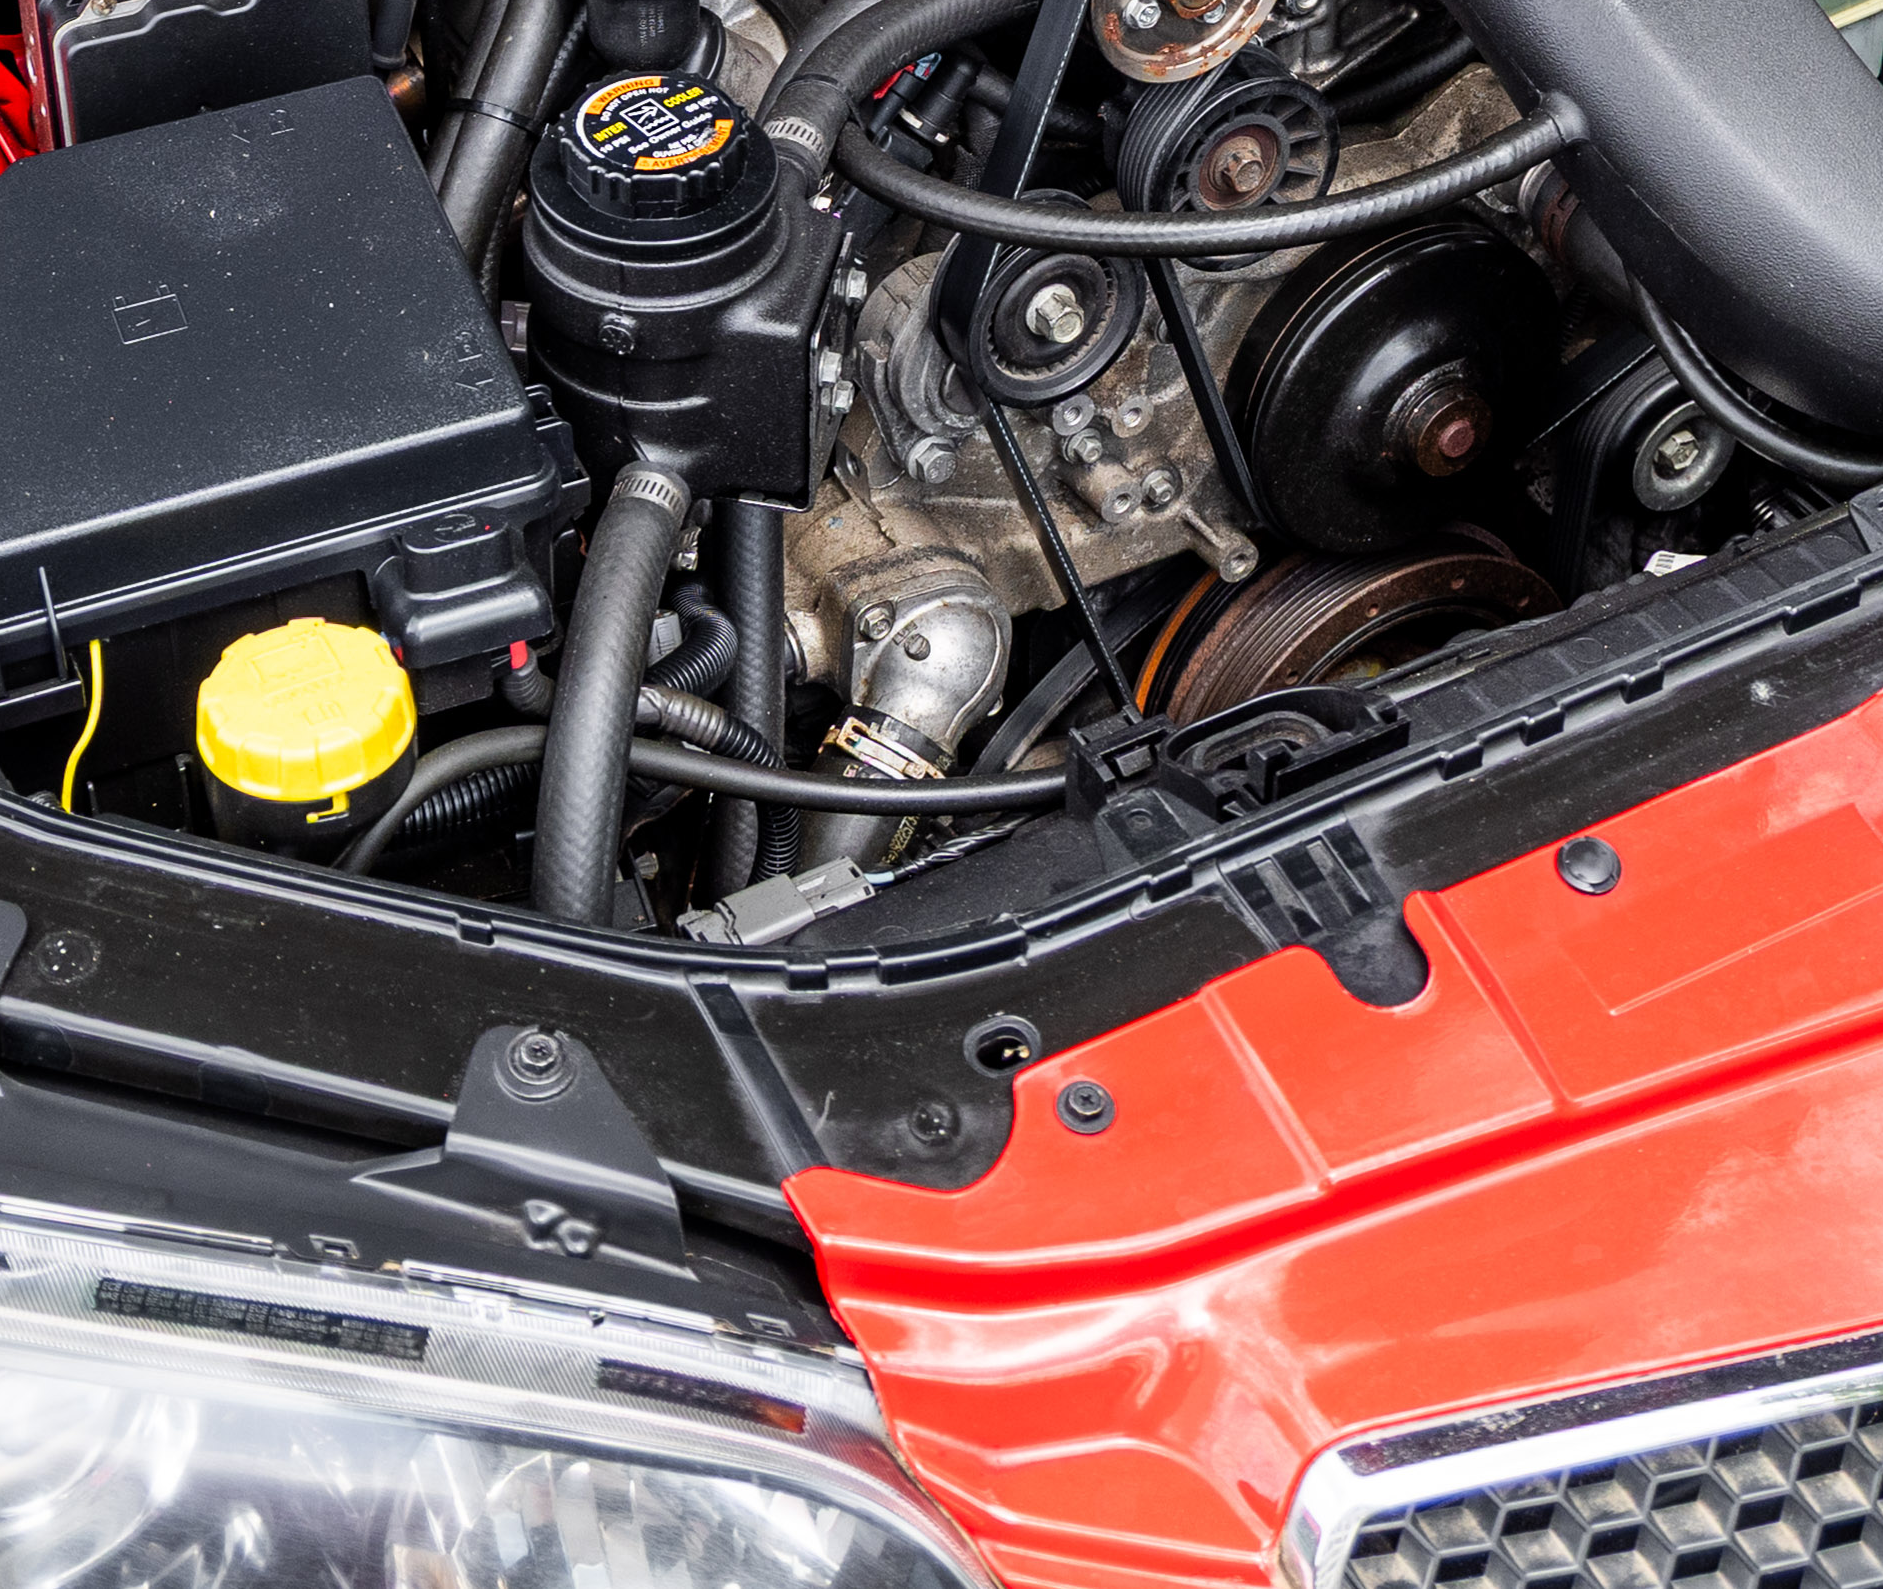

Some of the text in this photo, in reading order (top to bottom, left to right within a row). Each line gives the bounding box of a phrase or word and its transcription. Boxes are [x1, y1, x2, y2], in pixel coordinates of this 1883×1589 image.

[597, 78, 654, 104] WARNING
[592, 87, 704, 142] INTER COOLER
